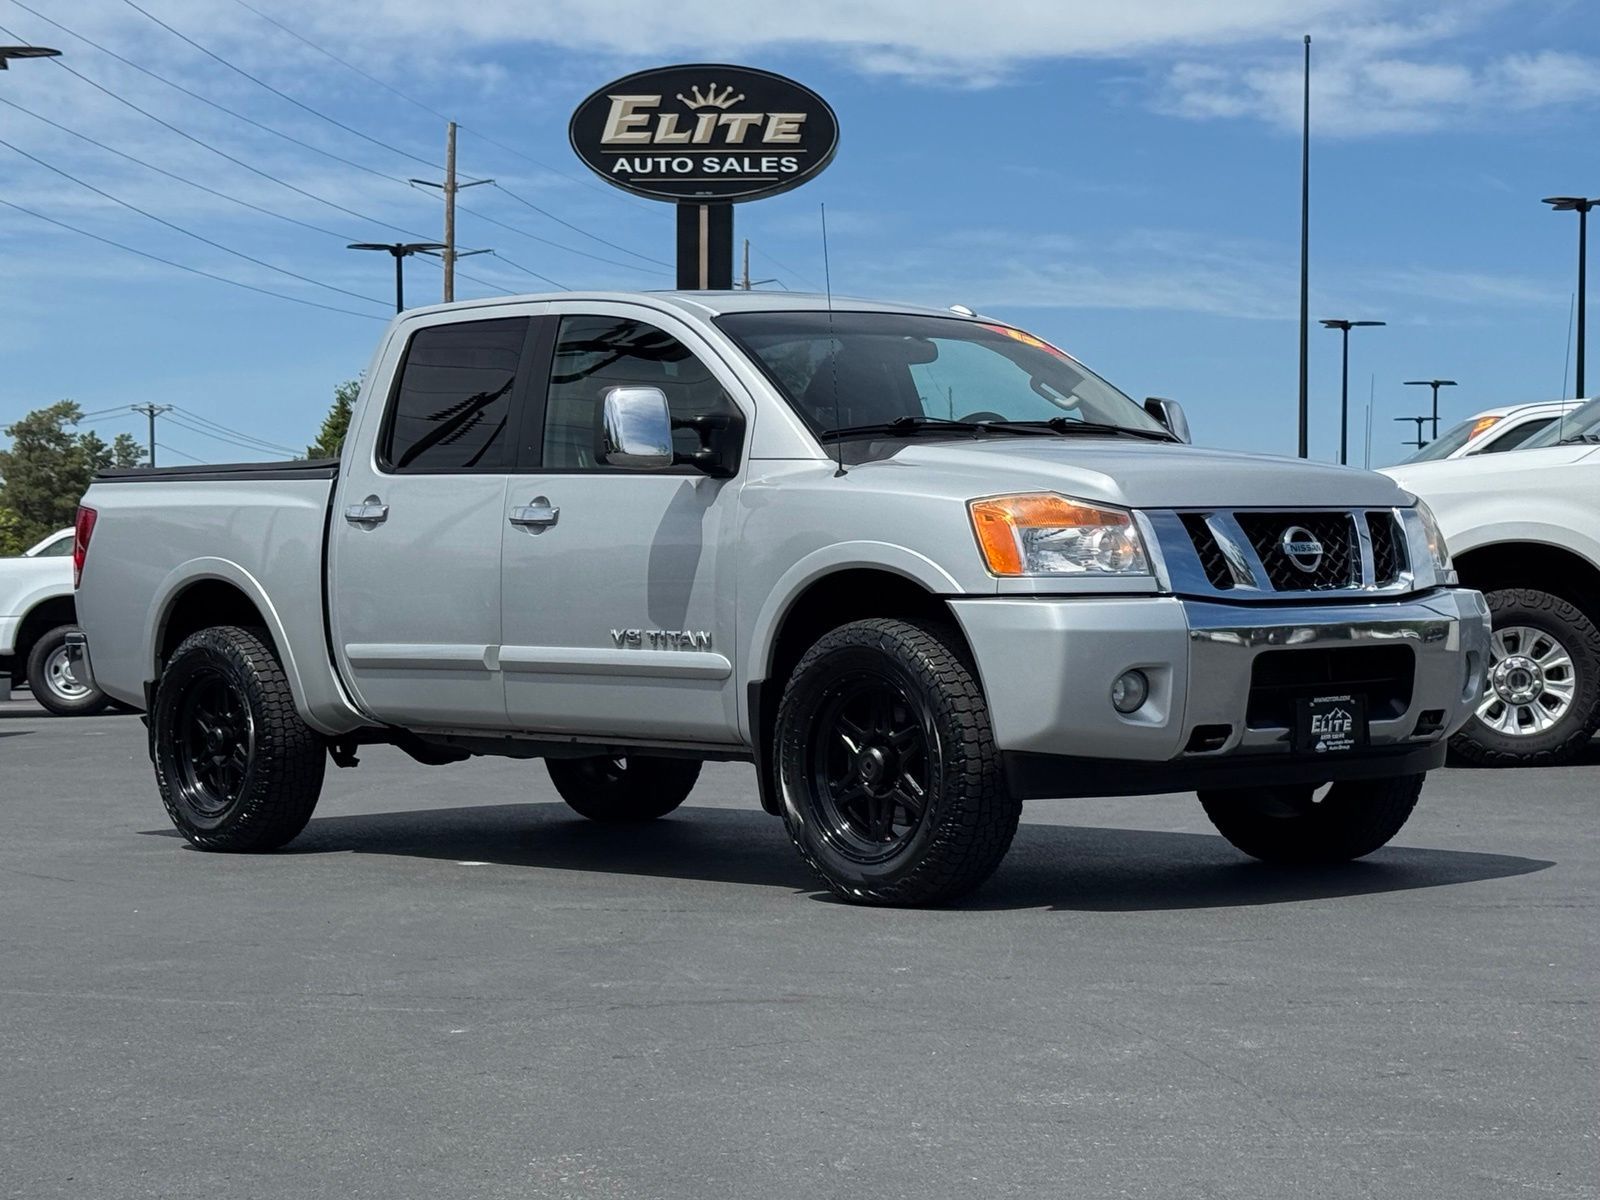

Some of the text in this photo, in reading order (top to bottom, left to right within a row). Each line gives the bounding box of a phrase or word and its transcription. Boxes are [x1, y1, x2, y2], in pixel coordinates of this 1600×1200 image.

[600, 95, 808, 144] ELITE
[612, 157, 799, 174] AUTO SALES
[1290, 544, 1322, 552] NISSAN
[610, 629, 712, 650] V8 TITAN
[1311, 715, 1352, 734] ELITE
